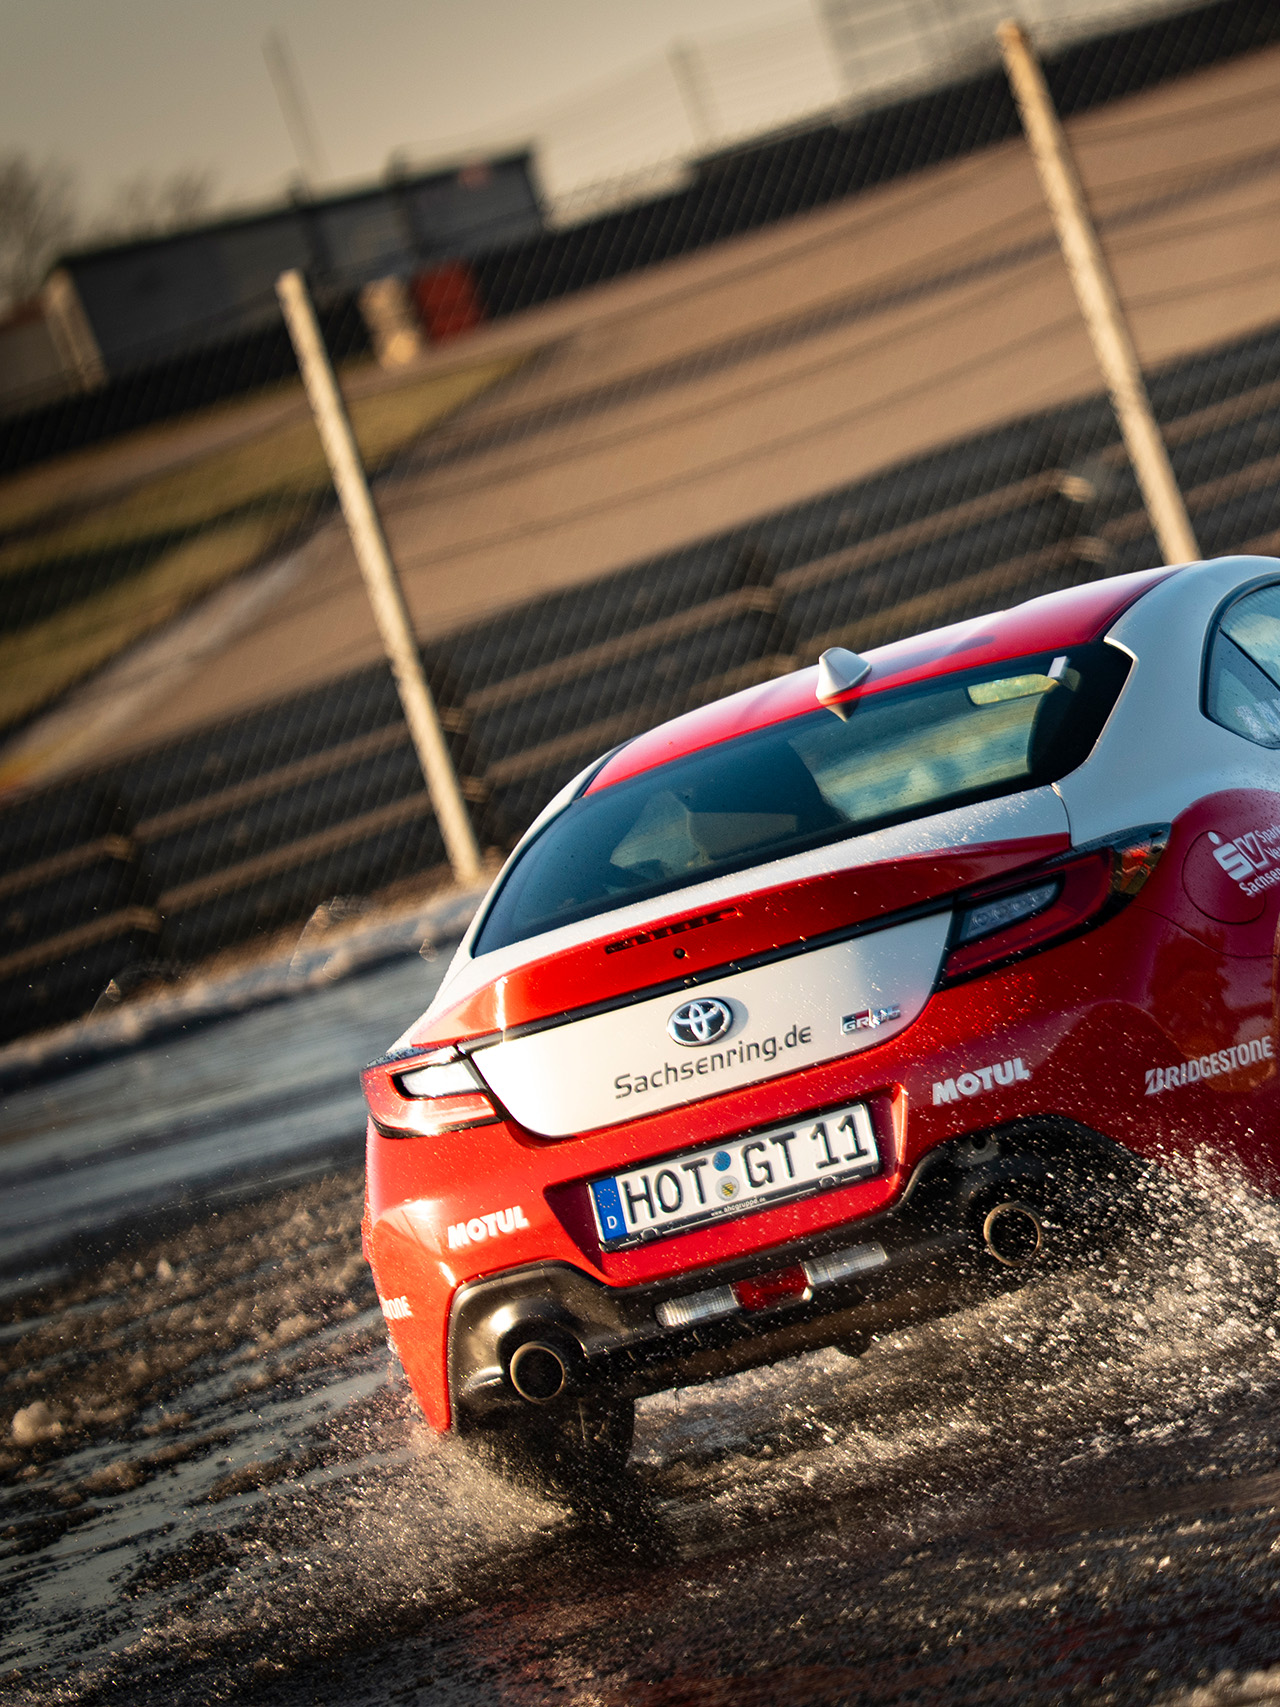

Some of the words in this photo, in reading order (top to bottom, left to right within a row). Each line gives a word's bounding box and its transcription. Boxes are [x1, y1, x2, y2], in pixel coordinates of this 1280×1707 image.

[614, 1024, 812, 1099] Sachsenring.de
[932, 1057, 1030, 1105] MOTUL
[1145, 1036, 1274, 1096] BRIDGESTONE
[621, 1157, 708, 1225] HOT
[741, 1131, 796, 1188] GT
[810, 1114, 869, 1169] 11
[447, 1205, 531, 1250] MOTUL
[607, 1215, 617, 1229] D
